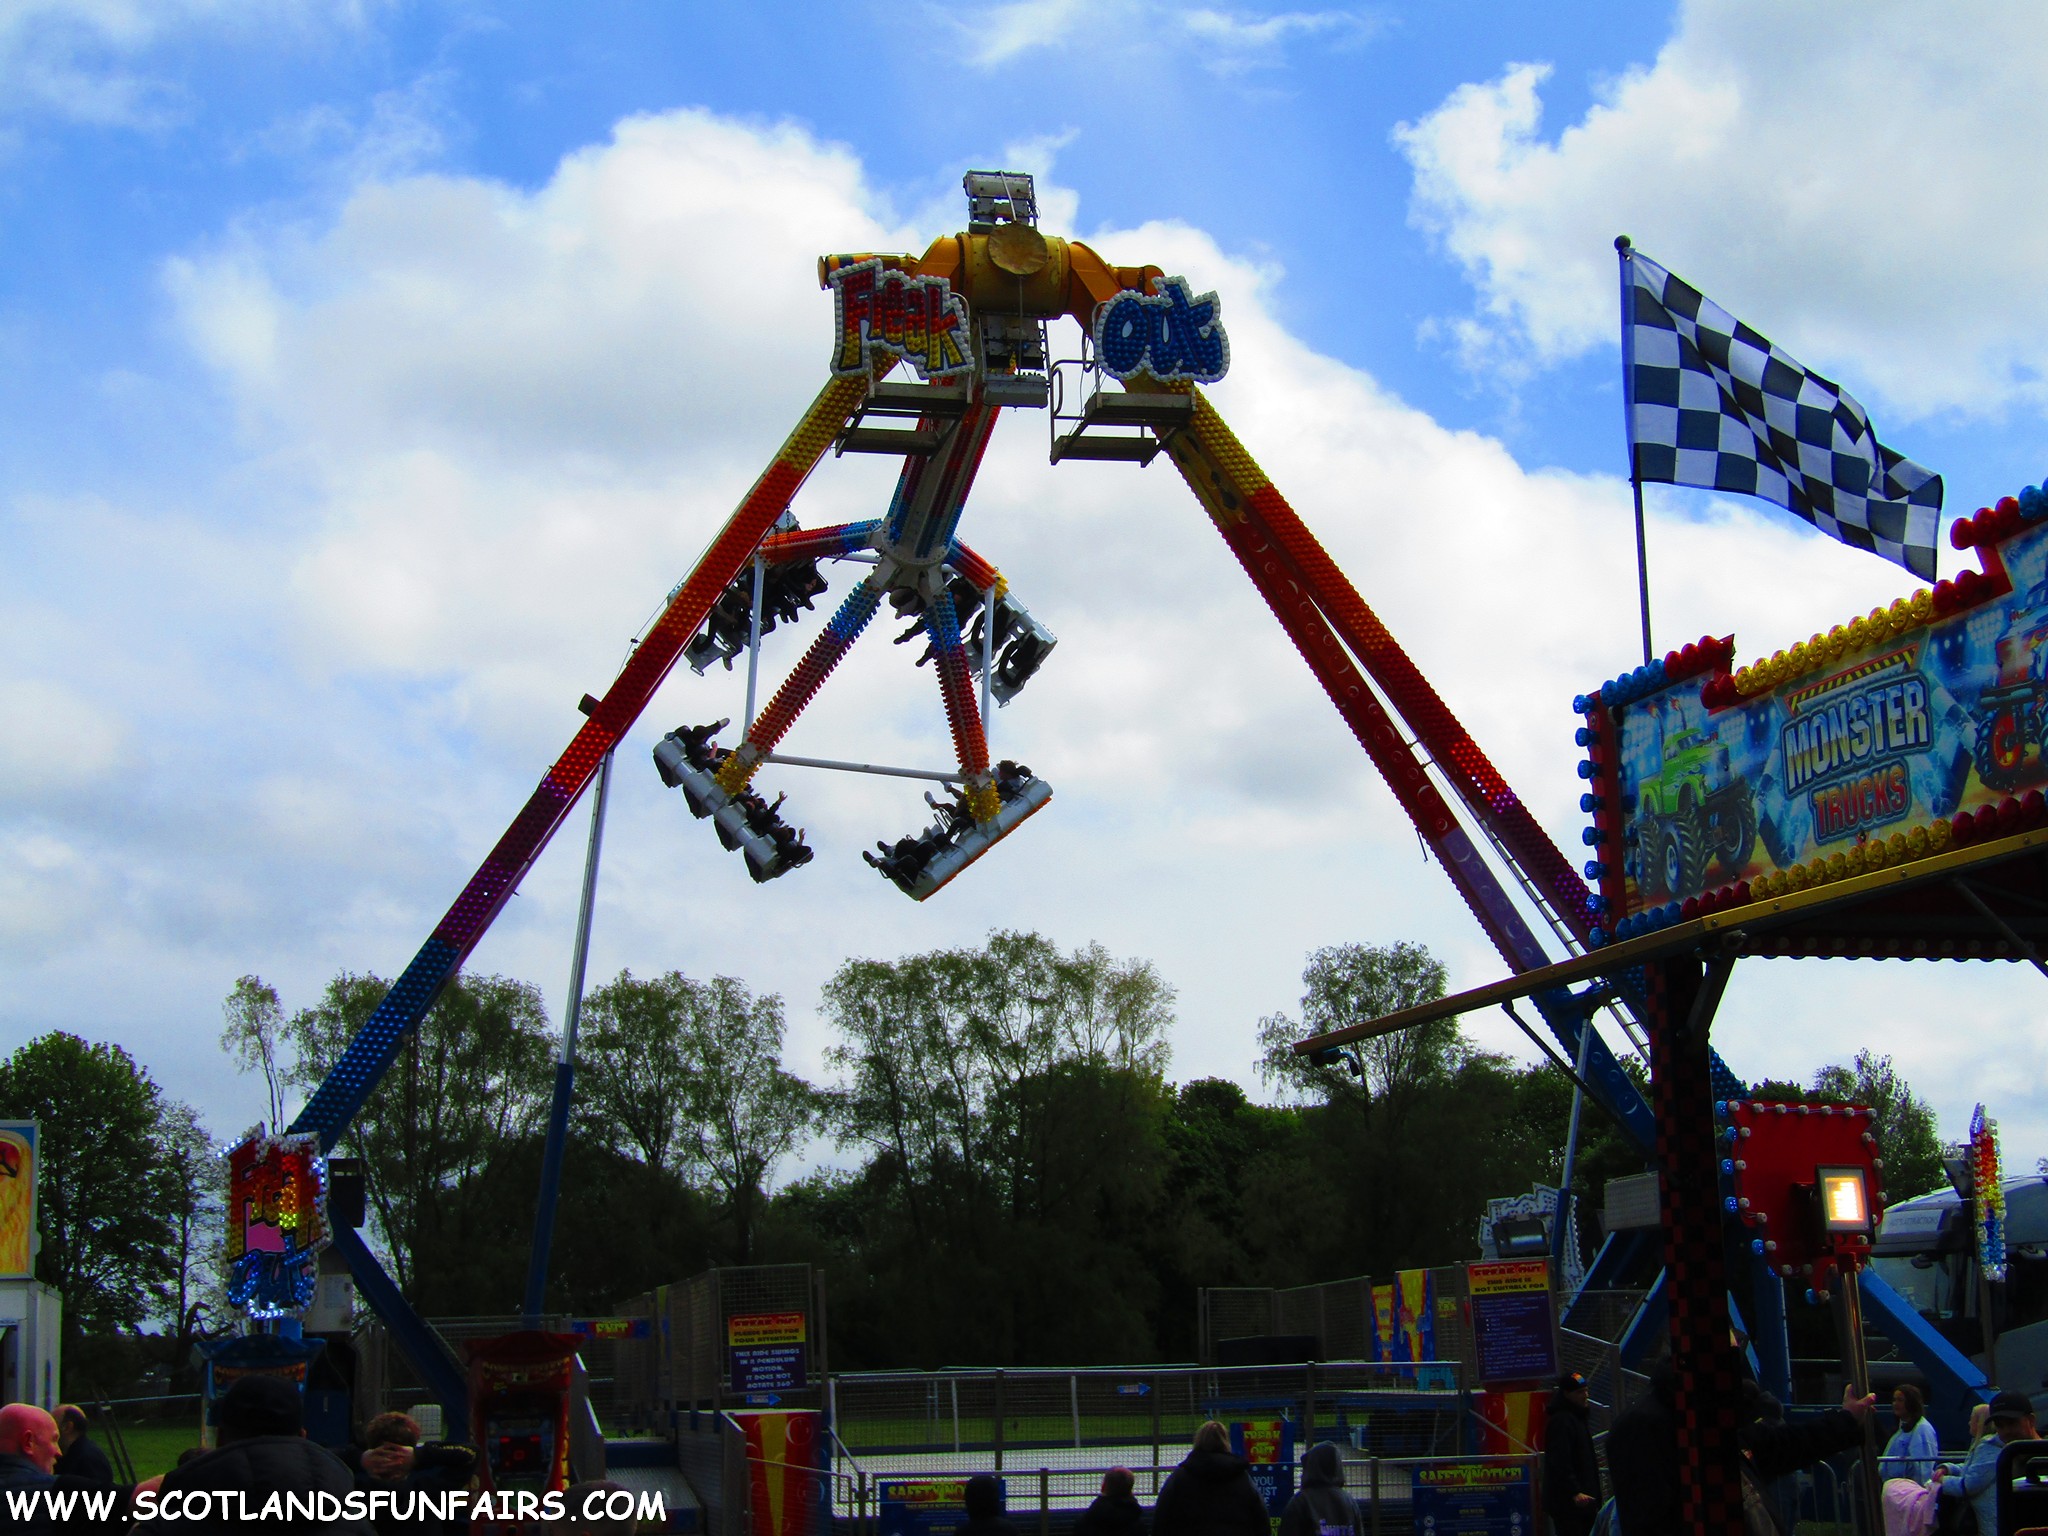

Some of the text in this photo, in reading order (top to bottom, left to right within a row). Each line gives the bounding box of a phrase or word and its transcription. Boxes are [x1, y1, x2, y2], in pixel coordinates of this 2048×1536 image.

[1783, 679, 1928, 791] MONSTER
[1813, 764, 1906, 836] TRUCKS
[1493, 1284, 1527, 1292] SUITABLE
[770, 1348, 801, 1356] SWINGS
[756, 1356, 796, 1365] PENDULUM
[754, 1373, 774, 1381] DOES
[775, 1372, 792, 1380] NOT
[1243, 1430, 1281, 1440] FREAK
[1250, 1444, 1276, 1456] OUT
[1252, 1475, 1274, 1487] YOU
[1418, 1468, 1468, 1486] SAFETY
[887, 1484, 940, 1502] SAFETY
